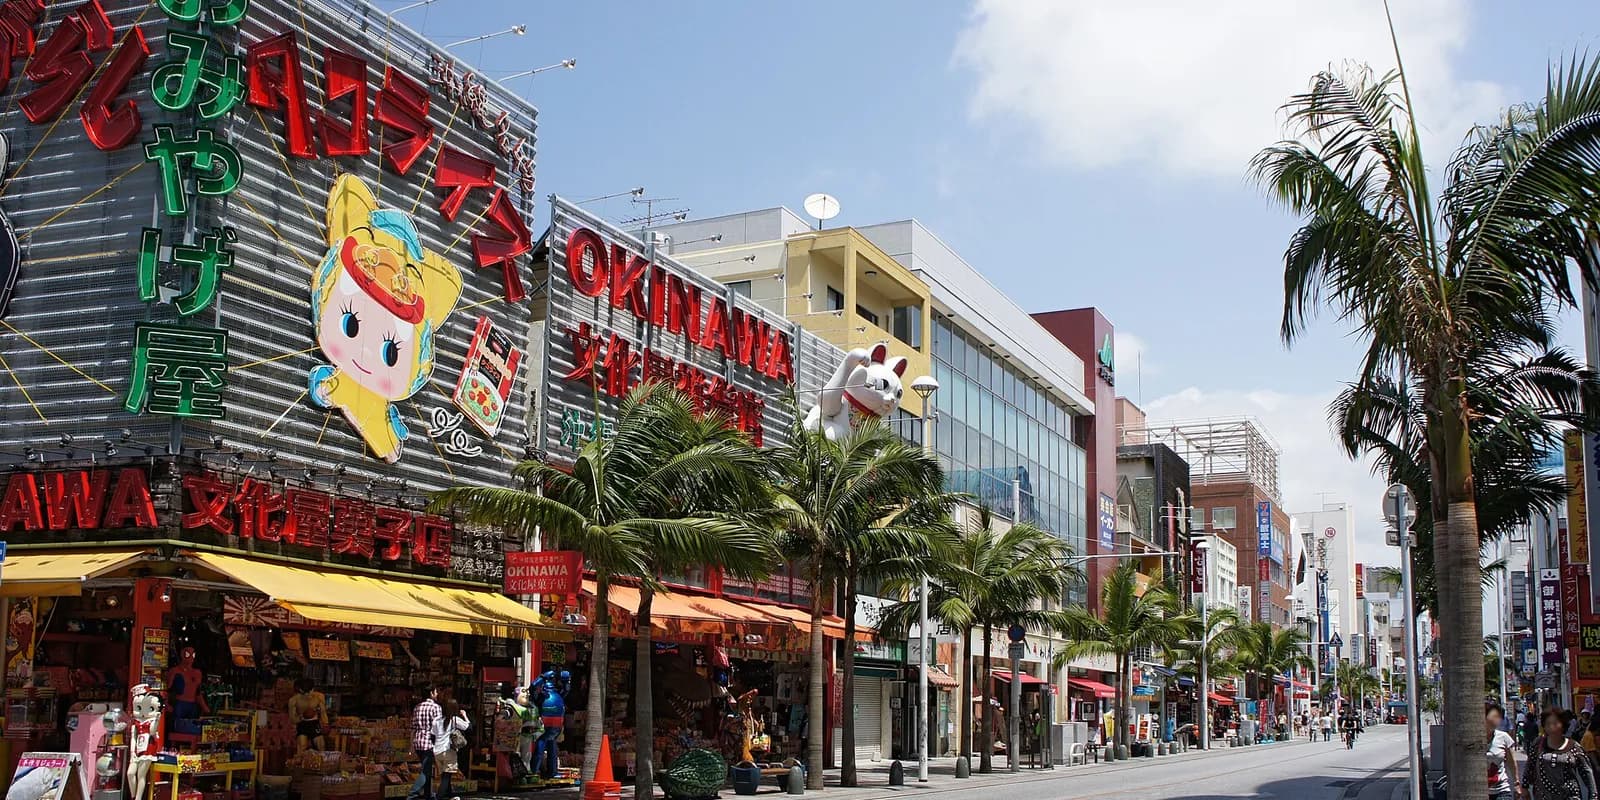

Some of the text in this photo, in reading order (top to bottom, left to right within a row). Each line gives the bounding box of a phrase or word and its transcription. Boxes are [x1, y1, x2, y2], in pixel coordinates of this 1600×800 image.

[246, 30, 533, 303] タコライス
[566, 227, 795, 386] OKINAWA
[0, 467, 159, 532] AWA
[182, 468, 453, 568] 文化屋菓子店
[507, 564, 568, 576] OKINAWA
[509, 578, 567, 591] 文化屋菓子店
[1564, 560, 1577, 606] イニング
[1542, 585, 1558, 653] 御菓子御殿
